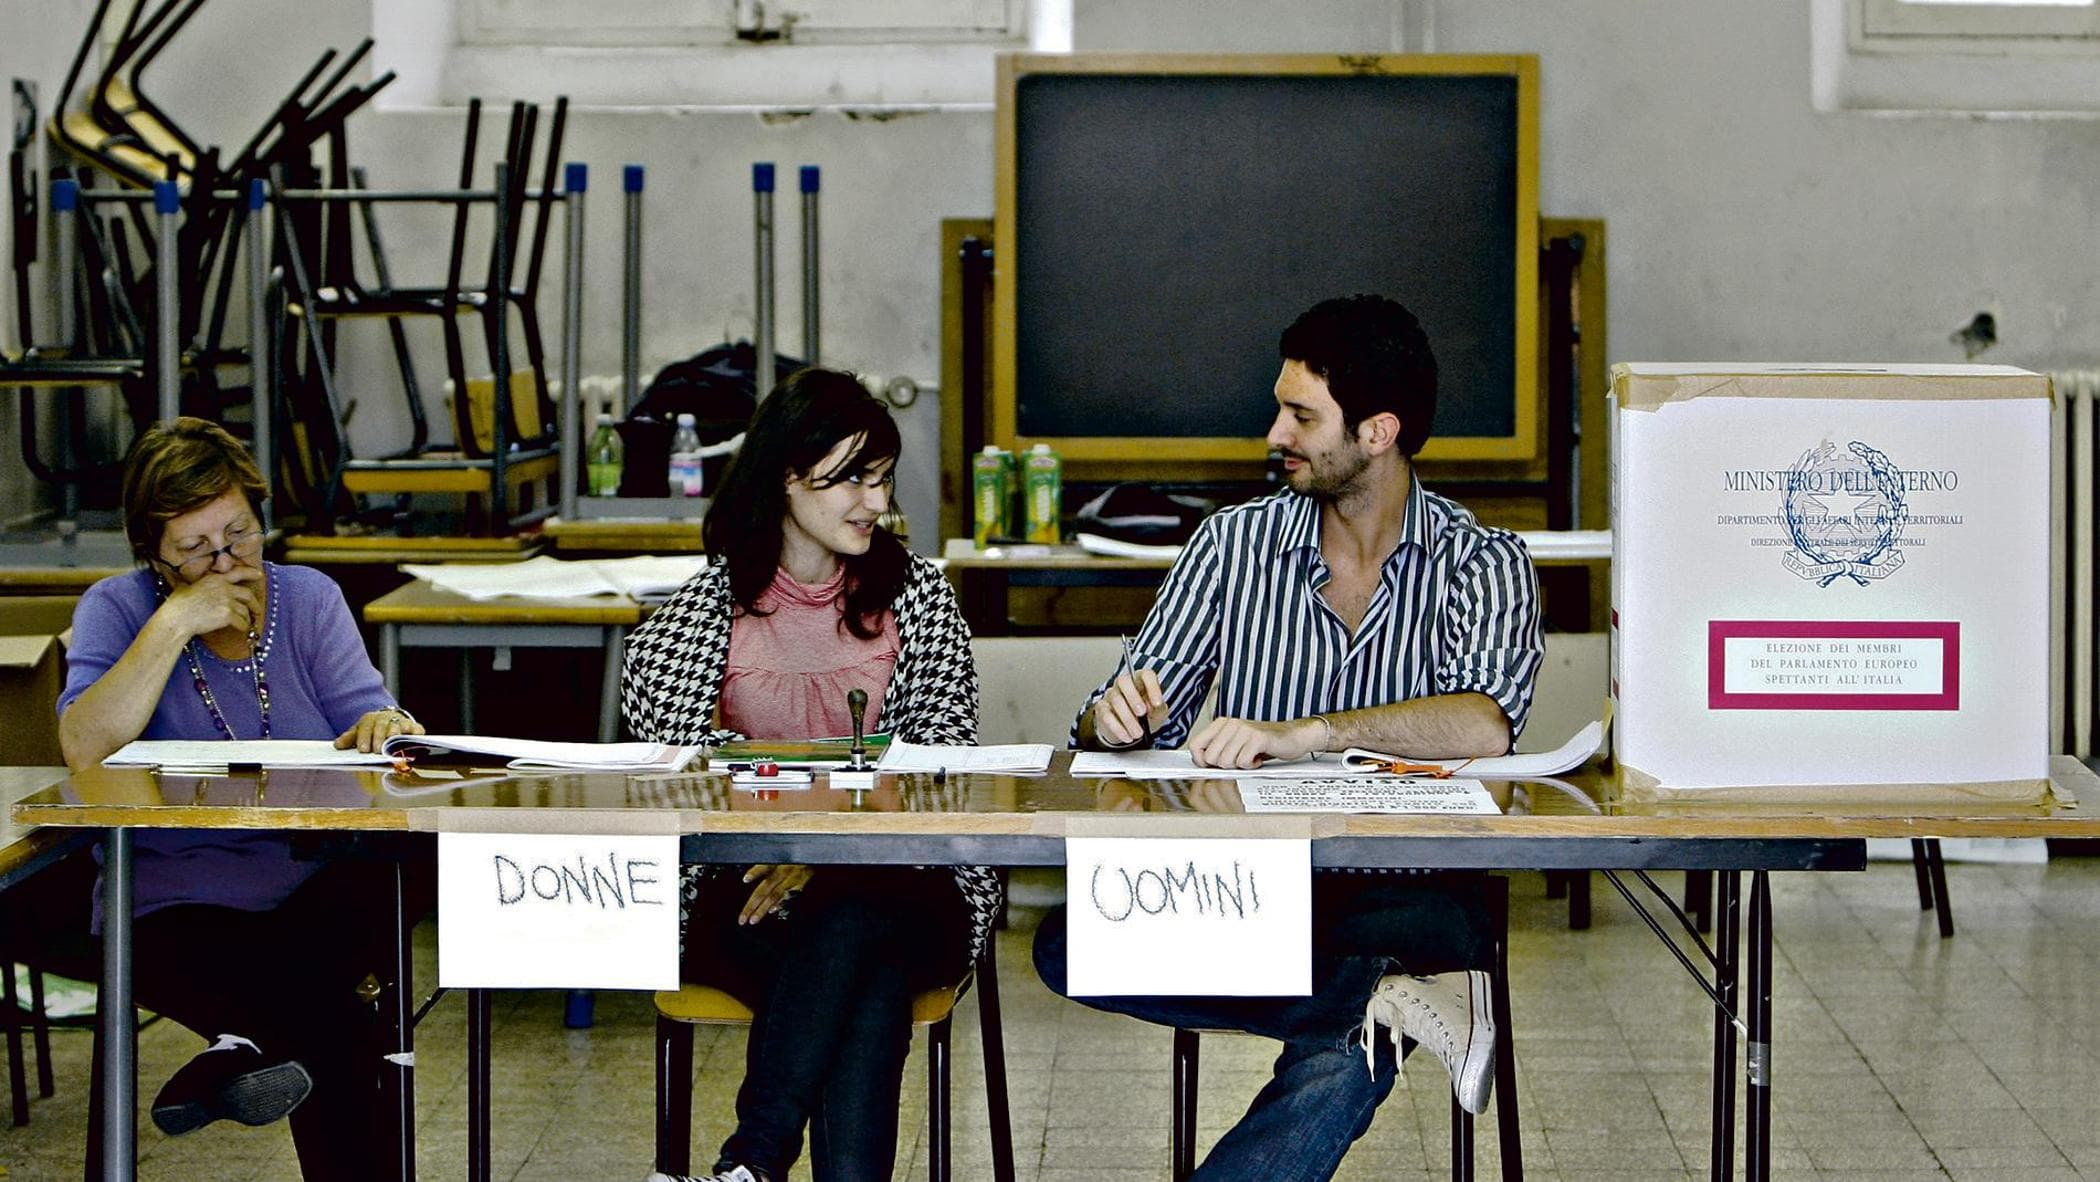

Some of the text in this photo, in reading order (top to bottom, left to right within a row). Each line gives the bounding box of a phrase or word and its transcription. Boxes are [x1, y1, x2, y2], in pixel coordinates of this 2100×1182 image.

[1724, 471, 1958, 492] MINISTERO DELLITERNO
[1854, 515, 1891, 525] INTE
[1853, 556, 1902, 577] ITALIANA
[1766, 643, 1902, 654] ELEZIONE DEI MEMBRI
[1751, 659, 1918, 670] DEL PARLAMENTO EUROPEO
[1765, 674, 1829, 685] SPETTANTI
[495, 852, 663, 909] DONNE
[1091, 861, 1260, 921] UOMINI
